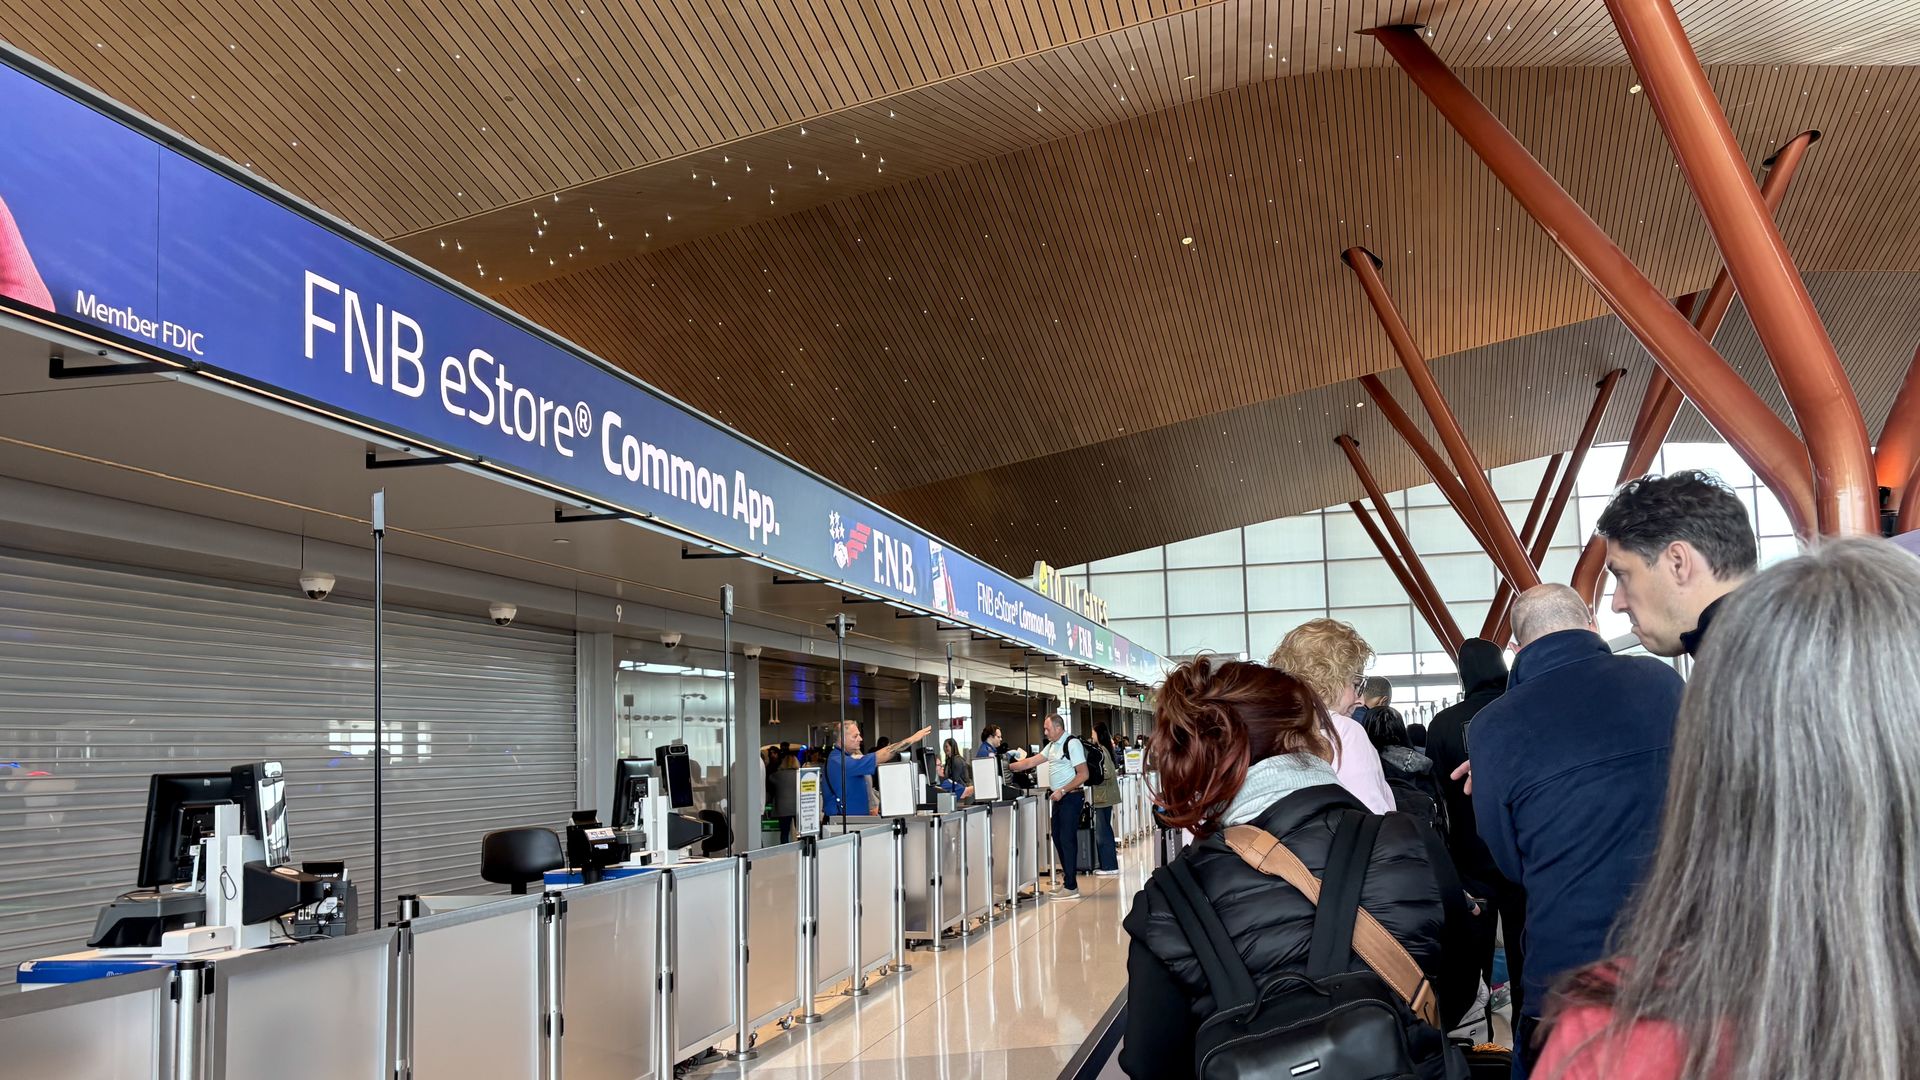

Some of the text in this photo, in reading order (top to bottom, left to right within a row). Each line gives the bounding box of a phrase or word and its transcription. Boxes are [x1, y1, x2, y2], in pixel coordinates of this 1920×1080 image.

[76, 290, 205, 356] Member FDIC
[303, 269, 427, 398] FNB
[602, 410, 728, 516] Common
[732, 470, 781, 546] App.
[872, 528, 917, 597] F.N.B.
[615, 603, 623, 623] 9
[977, 581, 994, 617] FNB
[1019, 601, 1045, 635] Common
[1046, 565, 1062, 604] TO
[1083, 588, 1109, 627] GATES
